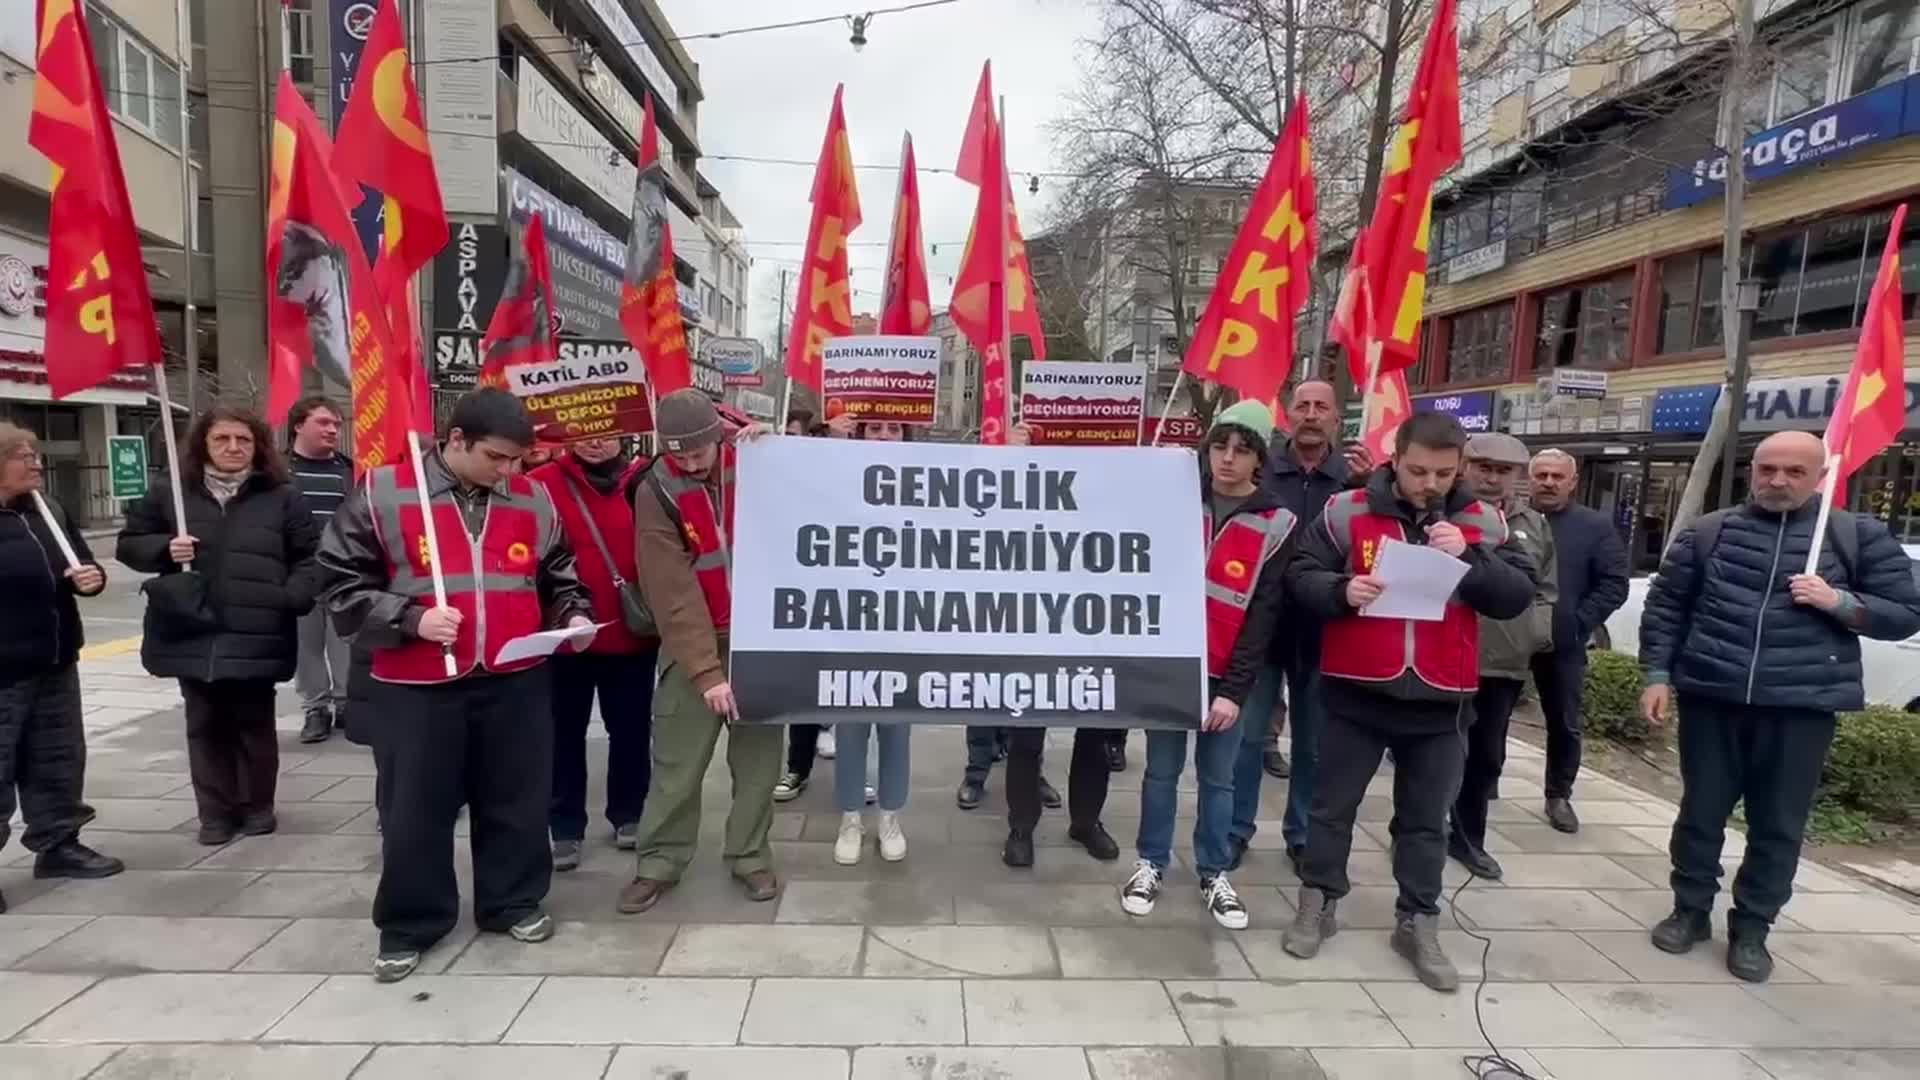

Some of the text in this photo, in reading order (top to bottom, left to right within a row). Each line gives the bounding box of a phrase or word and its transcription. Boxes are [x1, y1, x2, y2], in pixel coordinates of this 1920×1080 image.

[1694, 115, 1838, 187] taaça
[457, 223, 480, 330] ASPAVA
[824, 346, 937, 360] BARINAMIYORUZ
[520, 364, 582, 387] KATİL
[586, 360, 630, 379] ABD
[824, 374, 936, 390] GEÇİNEMİYORUZ
[1025, 373, 1143, 386] BARINAMIYORUZ
[526, 384, 639, 411] ÜLKEMİZDEN
[844, 402, 872, 413] HKP
[1023, 401, 1141, 417] GEÇİNEMİYORUZ
[583, 418, 615, 433] HKP
[1046, 428, 1074, 440] HKP
[863, 463, 1079, 517] GENÇLİK
[796, 520, 1152, 577] GEÇİNEMİYOR
[773, 588, 1161, 636] BARINAMIYOR!
[818, 666, 1117, 717] HKP GENÇLİĞİ
